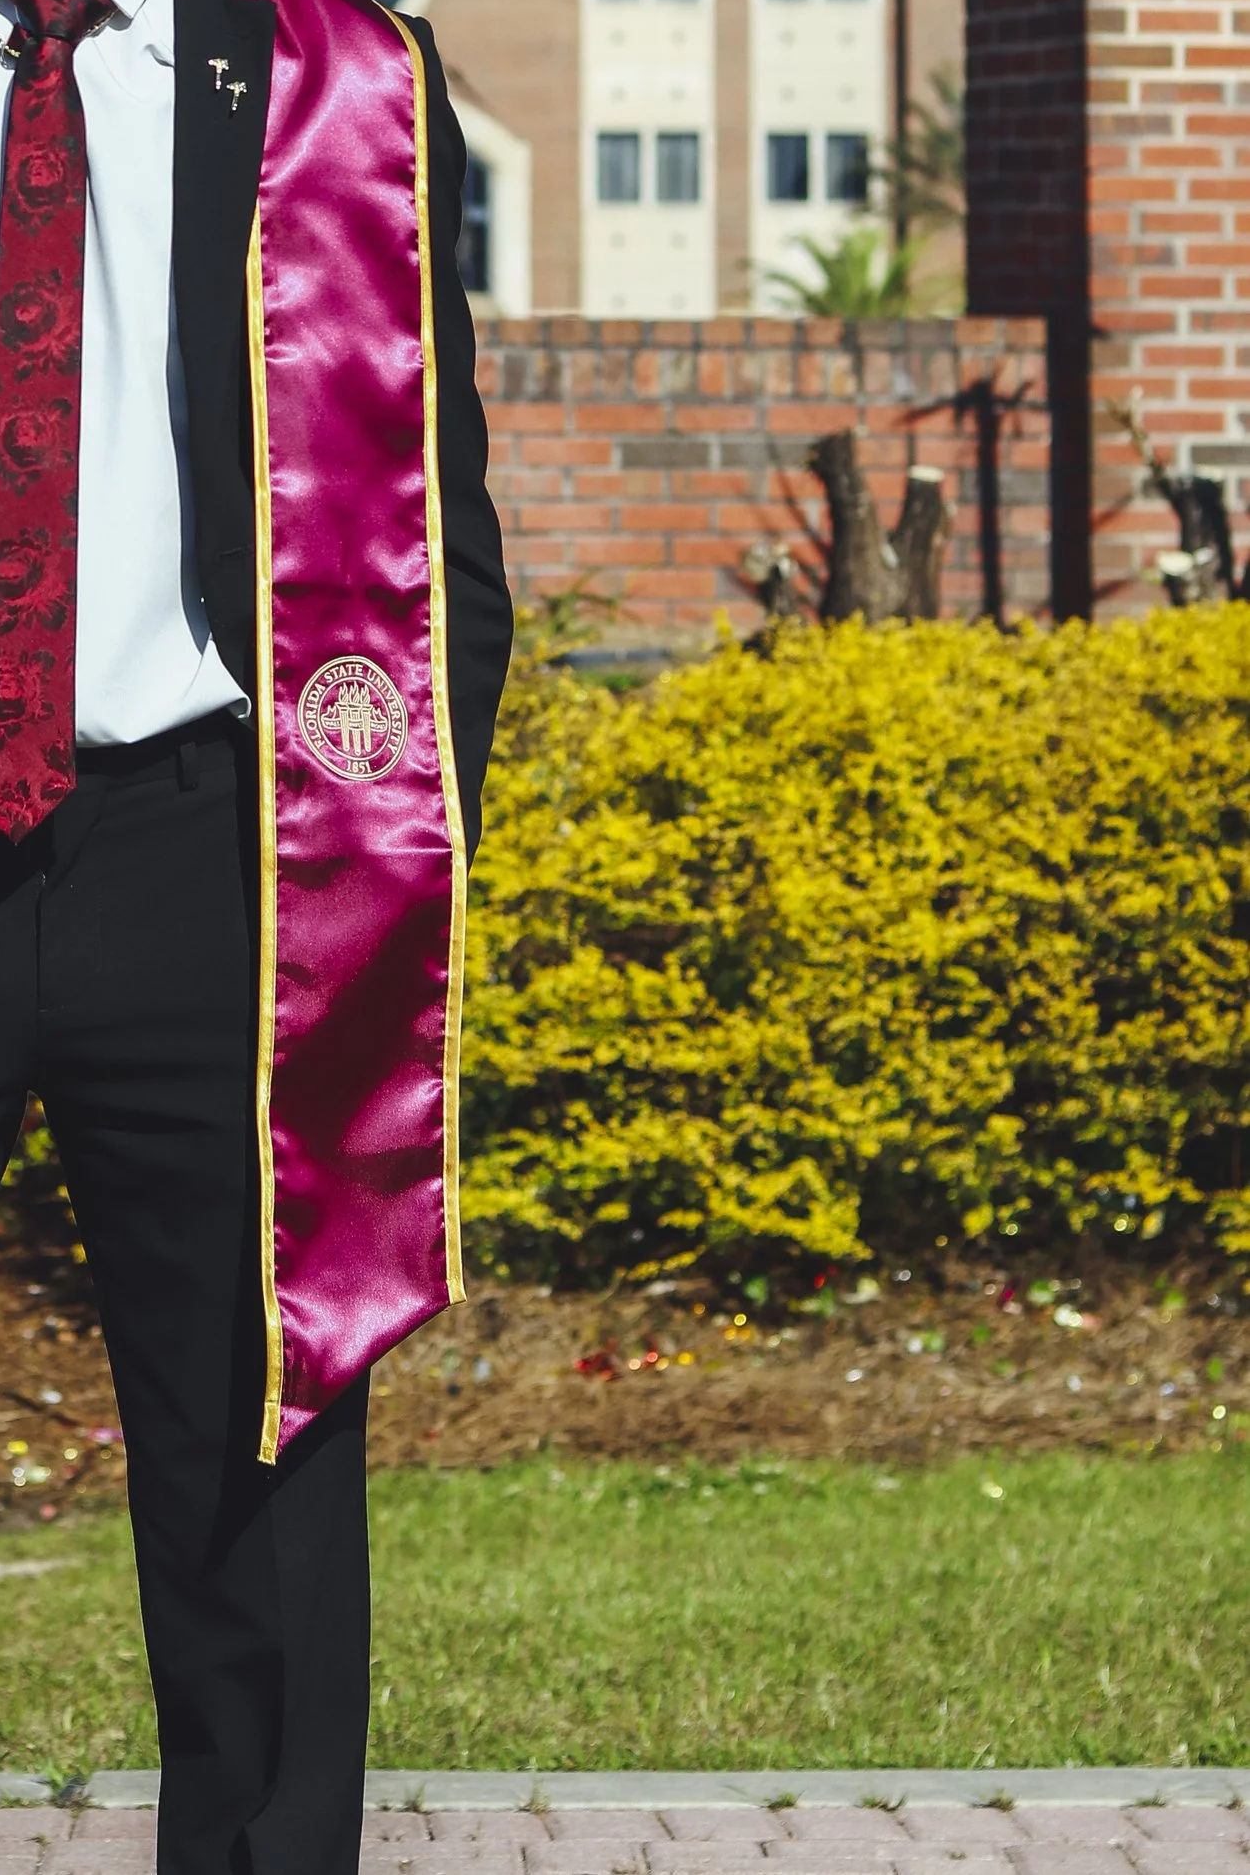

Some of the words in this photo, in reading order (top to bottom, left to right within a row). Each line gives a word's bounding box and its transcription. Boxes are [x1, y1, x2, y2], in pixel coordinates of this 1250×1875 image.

[306, 683, 325, 749] FLORIDA
[324, 664, 363, 683] STATE
[367, 671, 402, 754] UNIVERSITY
[346, 760, 373, 774] 1851
